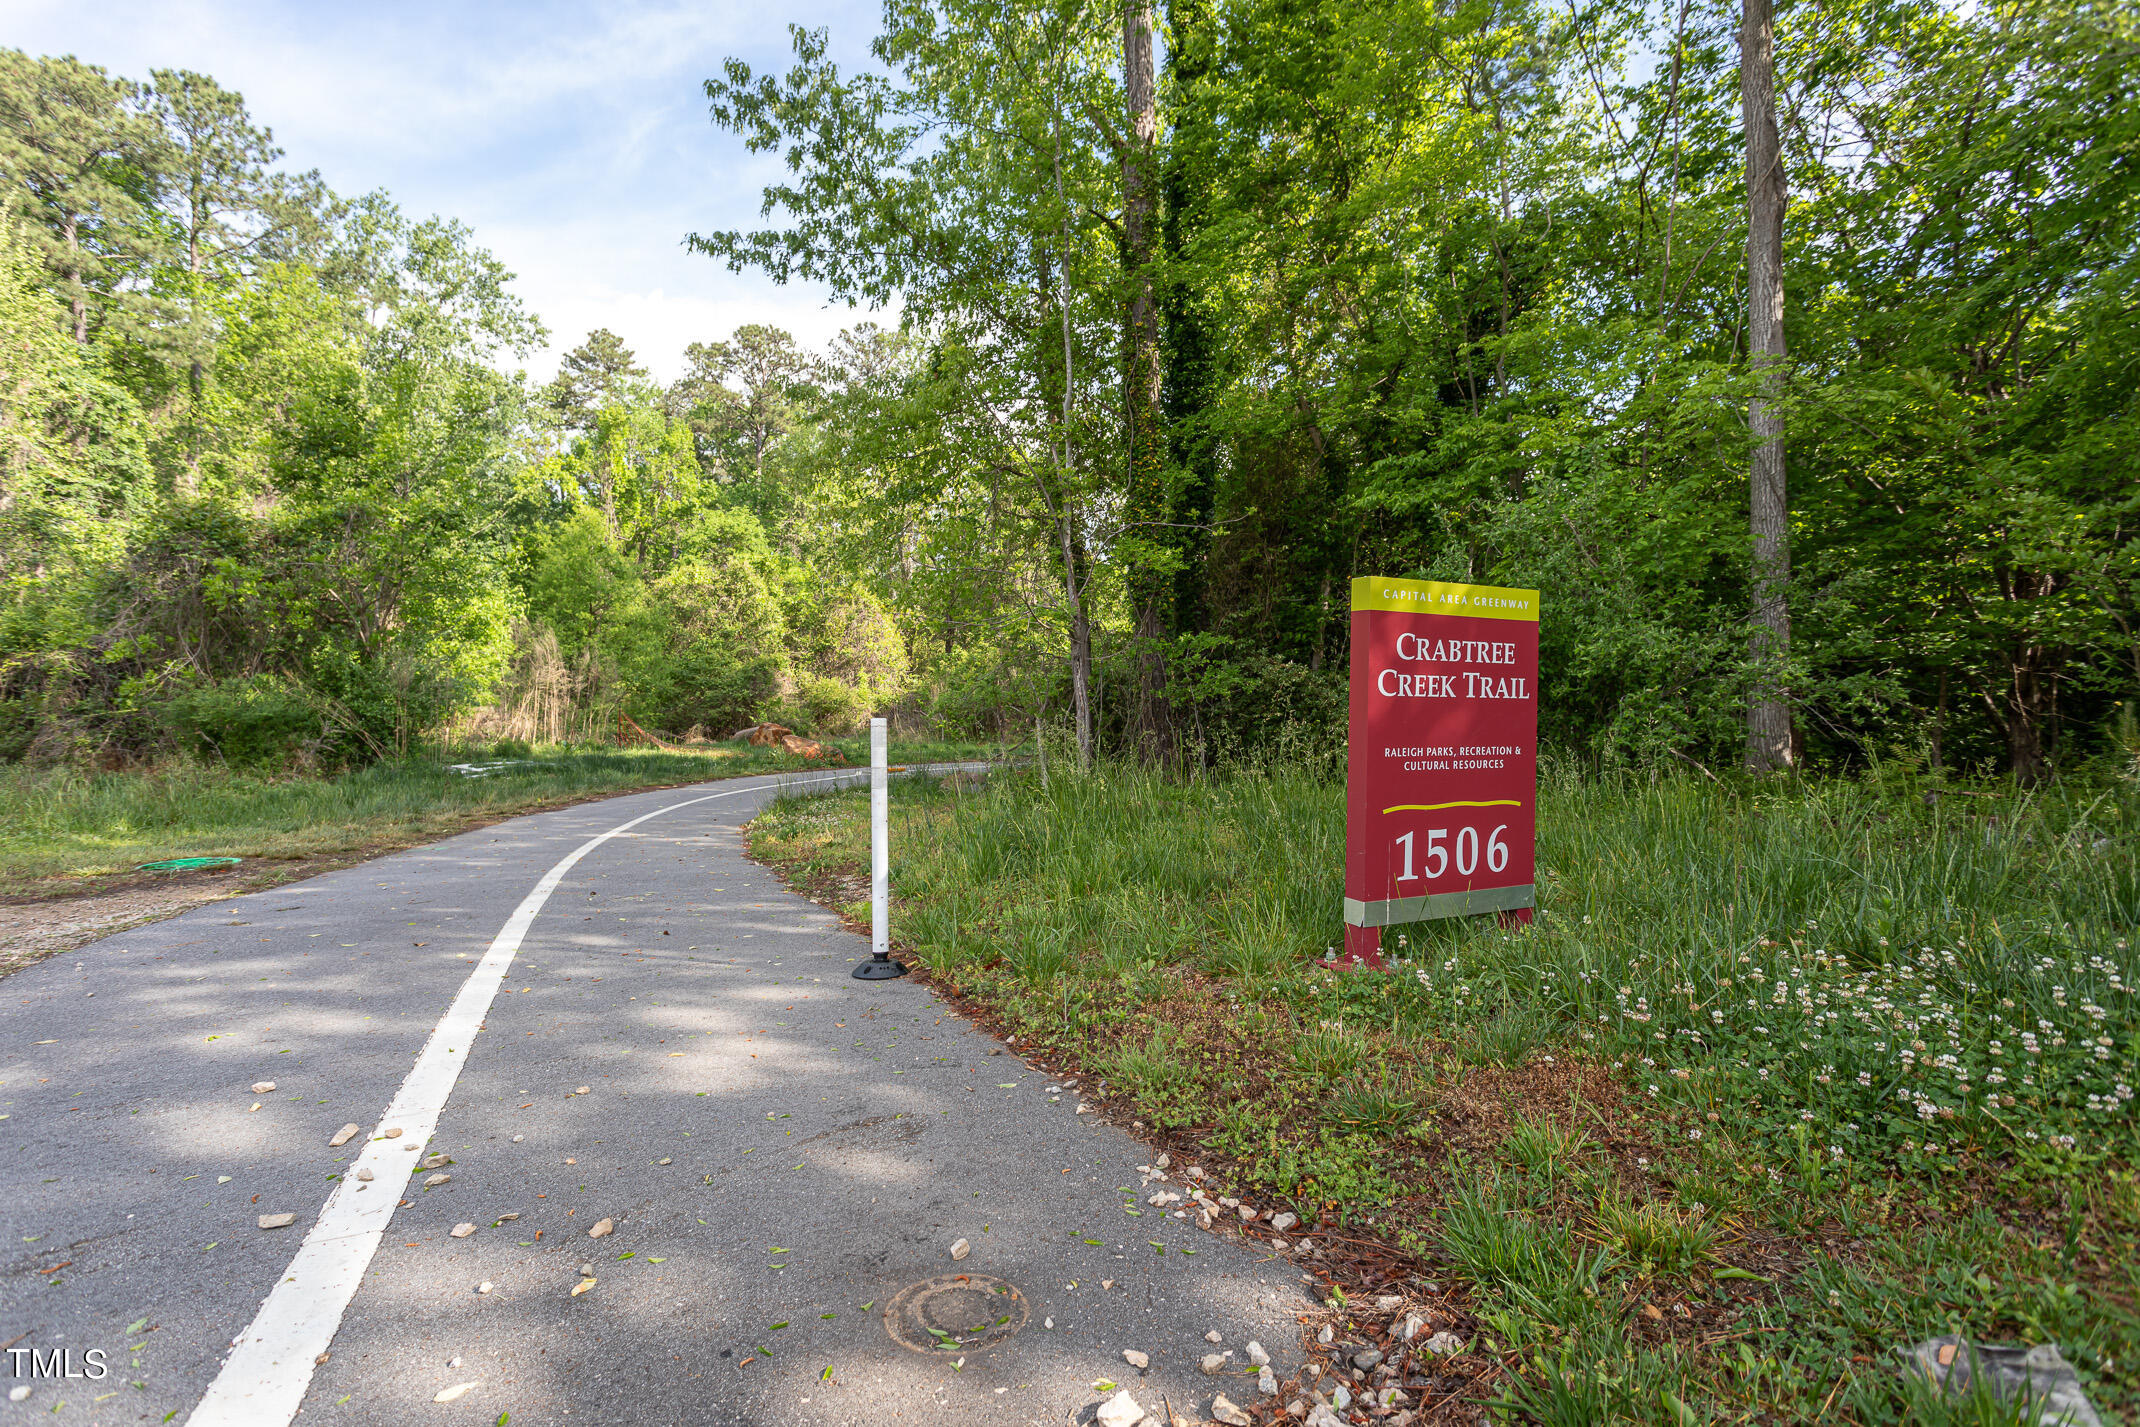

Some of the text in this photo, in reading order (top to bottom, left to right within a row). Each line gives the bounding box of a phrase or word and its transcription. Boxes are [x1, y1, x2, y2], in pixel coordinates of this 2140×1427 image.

[1384, 589, 1529, 609] CAPITAL AREA GREENWAY
[1396, 633, 1516, 665] CRABTREE
[1377, 669, 1530, 699] CREEK TRAIL
[1384, 746, 1521, 758] RALEIGH PARKS, RECREATION &
[1404, 760, 1504, 771] CULTURAL RESOURCES
[1395, 824, 1509, 882] 1506
